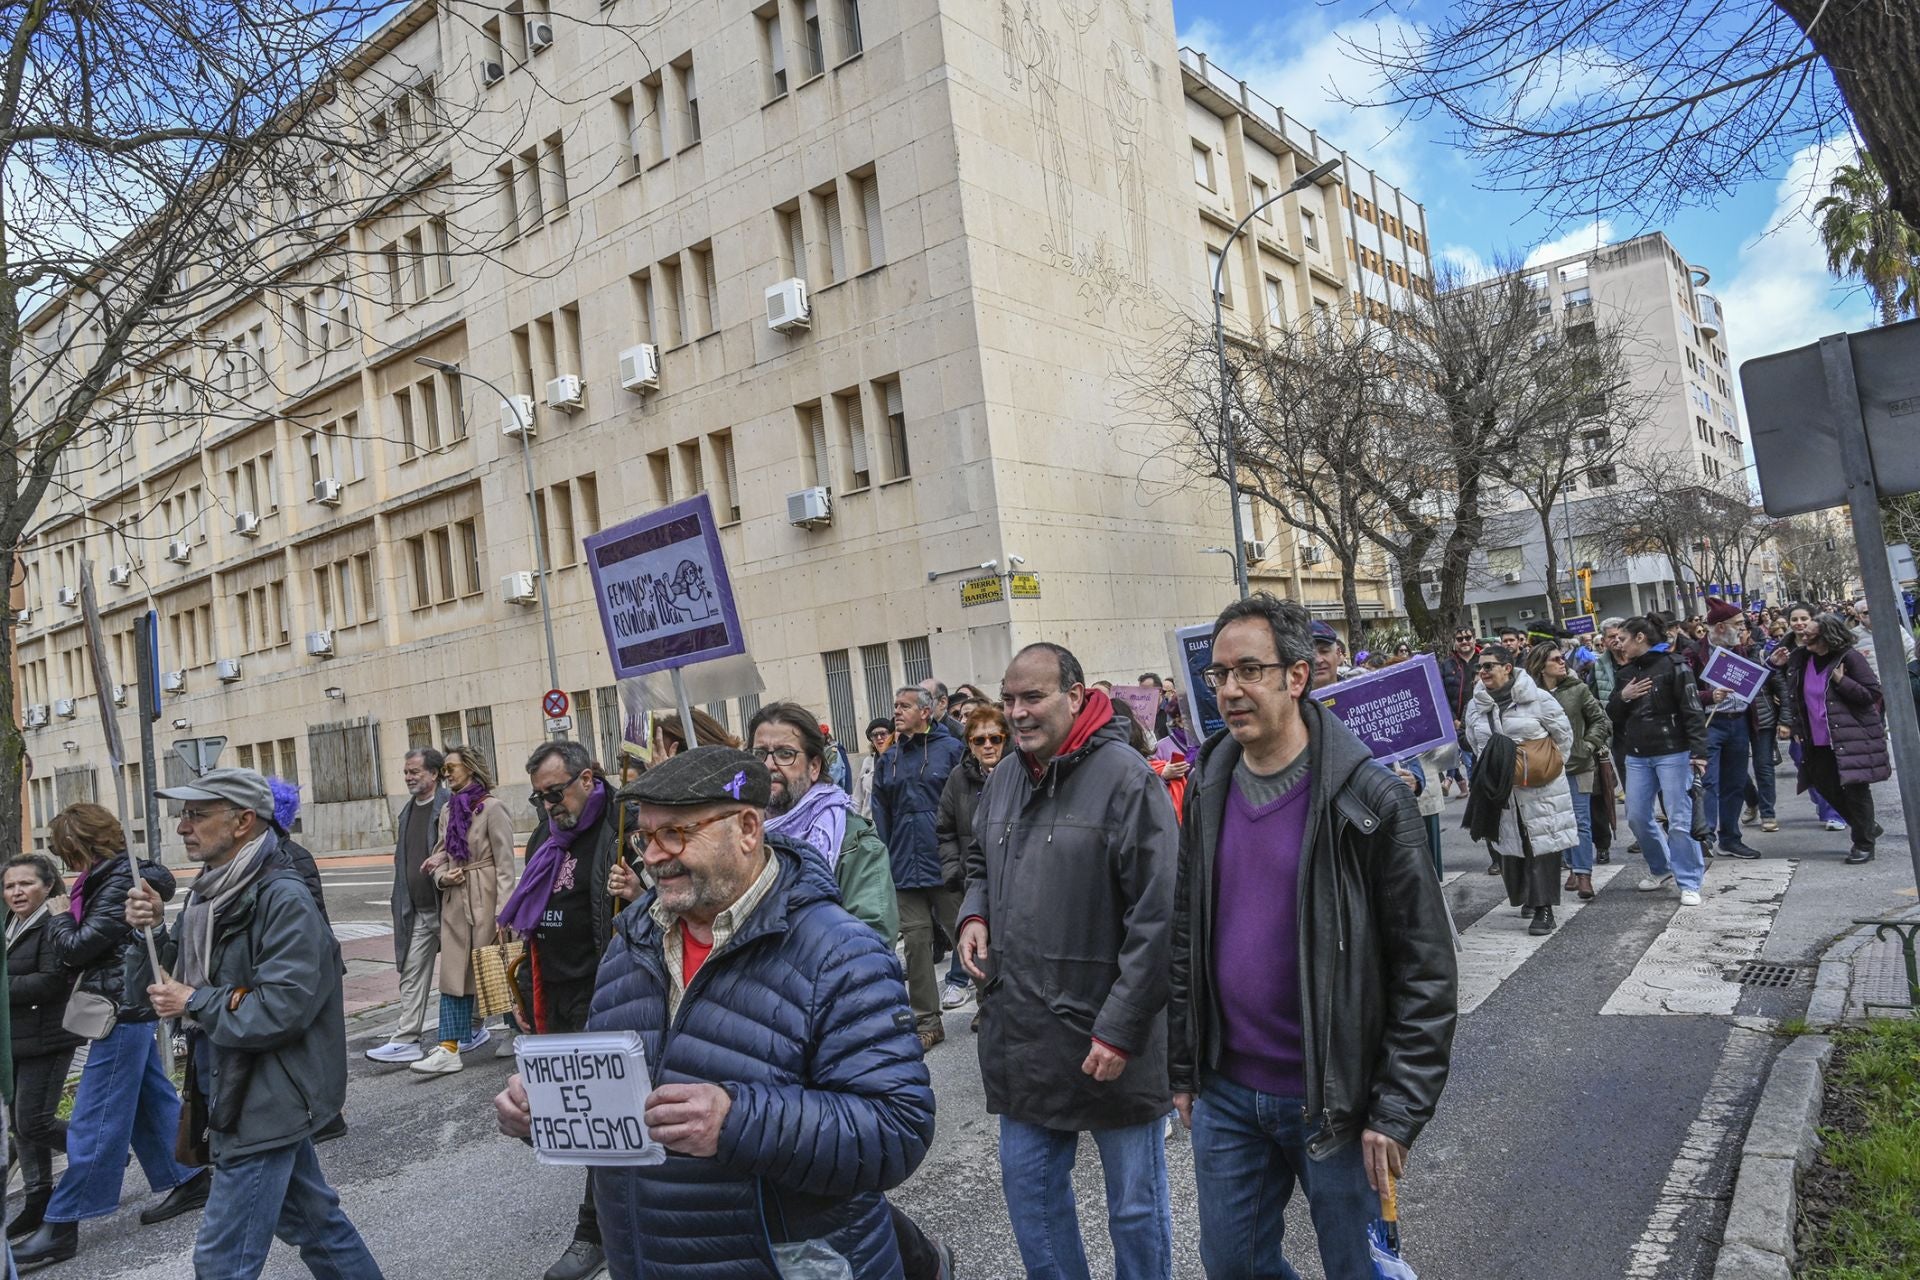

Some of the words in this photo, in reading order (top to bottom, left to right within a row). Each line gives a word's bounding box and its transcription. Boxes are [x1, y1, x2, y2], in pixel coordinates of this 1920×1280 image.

[970, 579, 996, 590] TIERRA
[964, 591, 999, 602] BARROS
[1188, 640, 1209, 652] ELLAS
[1346, 688, 1412, 720] ¡PARTICIPACIÓN
[1367, 709, 1384, 722] LAS
[1383, 697, 1420, 717] MUJERES
[1361, 721, 1378, 734] LOS
[1378, 707, 1422, 729] PROCESOS
[1371, 730, 1382, 741] DE
[1384, 723, 1404, 738] PAZ!
[559, 1085, 592, 1113] ES
